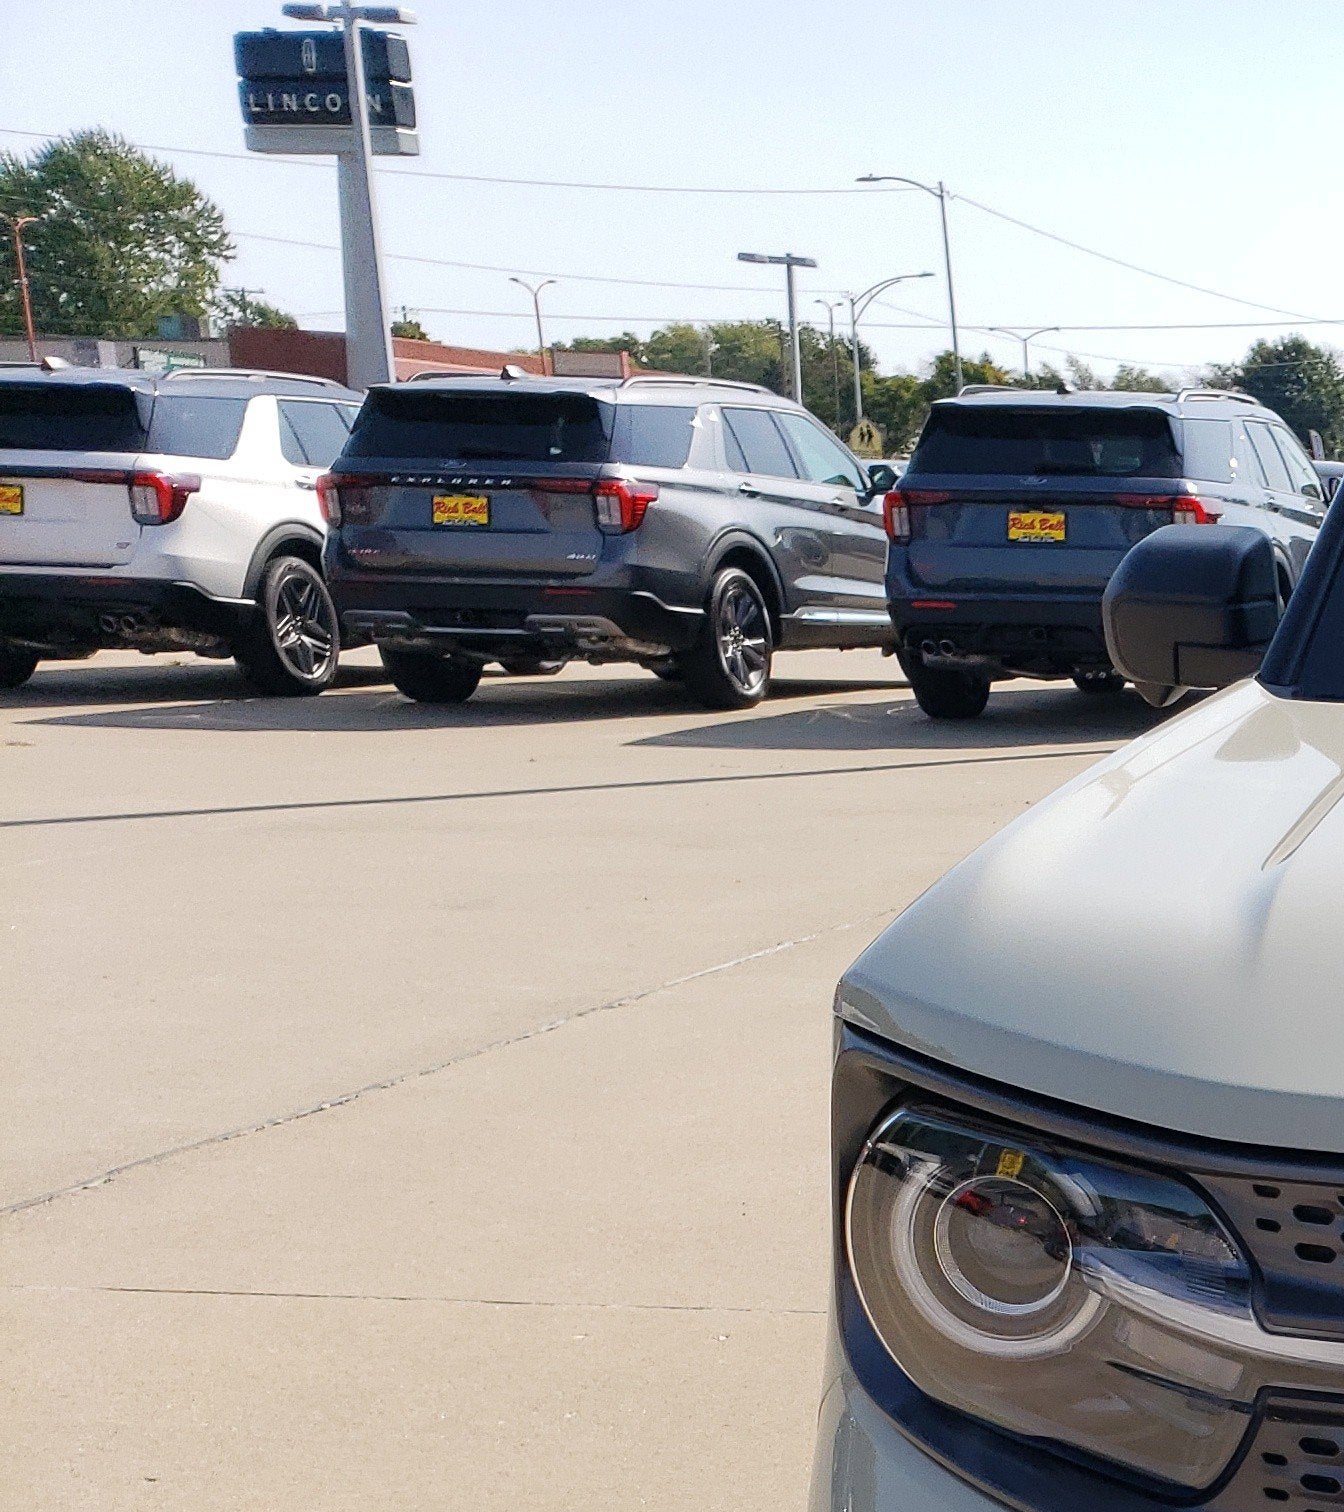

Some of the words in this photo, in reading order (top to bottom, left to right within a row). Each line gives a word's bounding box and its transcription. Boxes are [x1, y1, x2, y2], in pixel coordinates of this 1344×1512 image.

[249, 92, 383, 113] LINCON
[1009, 517, 1036, 530] Rick
[1038, 518, 1065, 531] Ball
